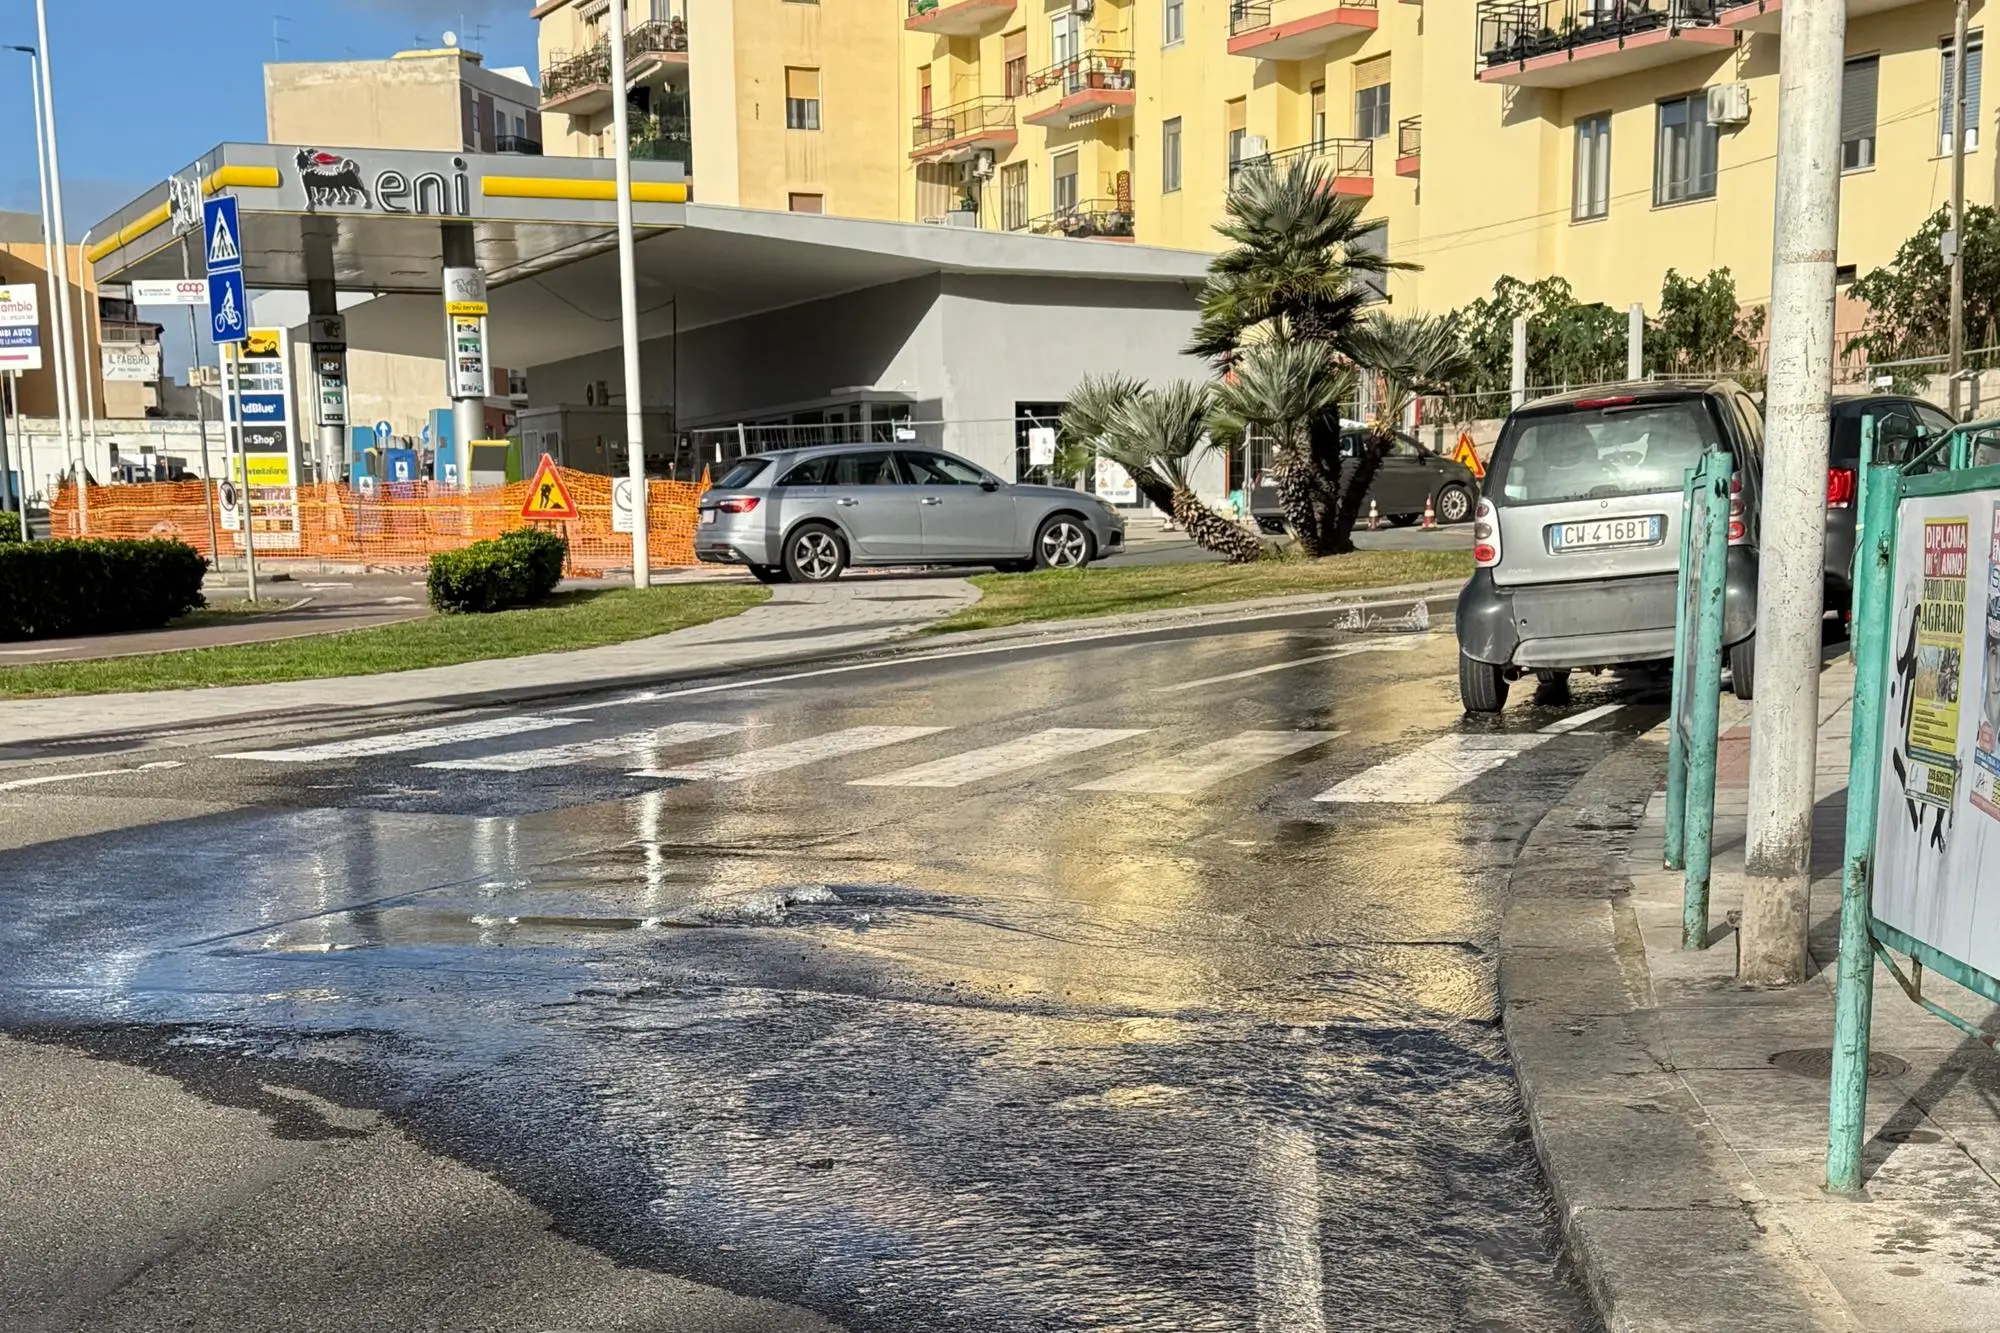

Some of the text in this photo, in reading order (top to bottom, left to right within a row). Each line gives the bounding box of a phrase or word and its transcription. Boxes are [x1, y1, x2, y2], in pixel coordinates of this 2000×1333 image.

[375, 156, 469, 215] eni
[176, 282, 205, 295] coop
[13, 328, 32, 337] AUTO
[252, 434, 275, 447] Shop
[1565, 525, 1585, 544] CW
[1592, 520, 1647, 542] 416BT
[1926, 525, 1966, 549] DIPLOMA
[1941, 552, 1967, 576] ANNO!
[1943, 579, 1966, 602] TECNICO
[1920, 602, 1964, 634] AGRARIO
